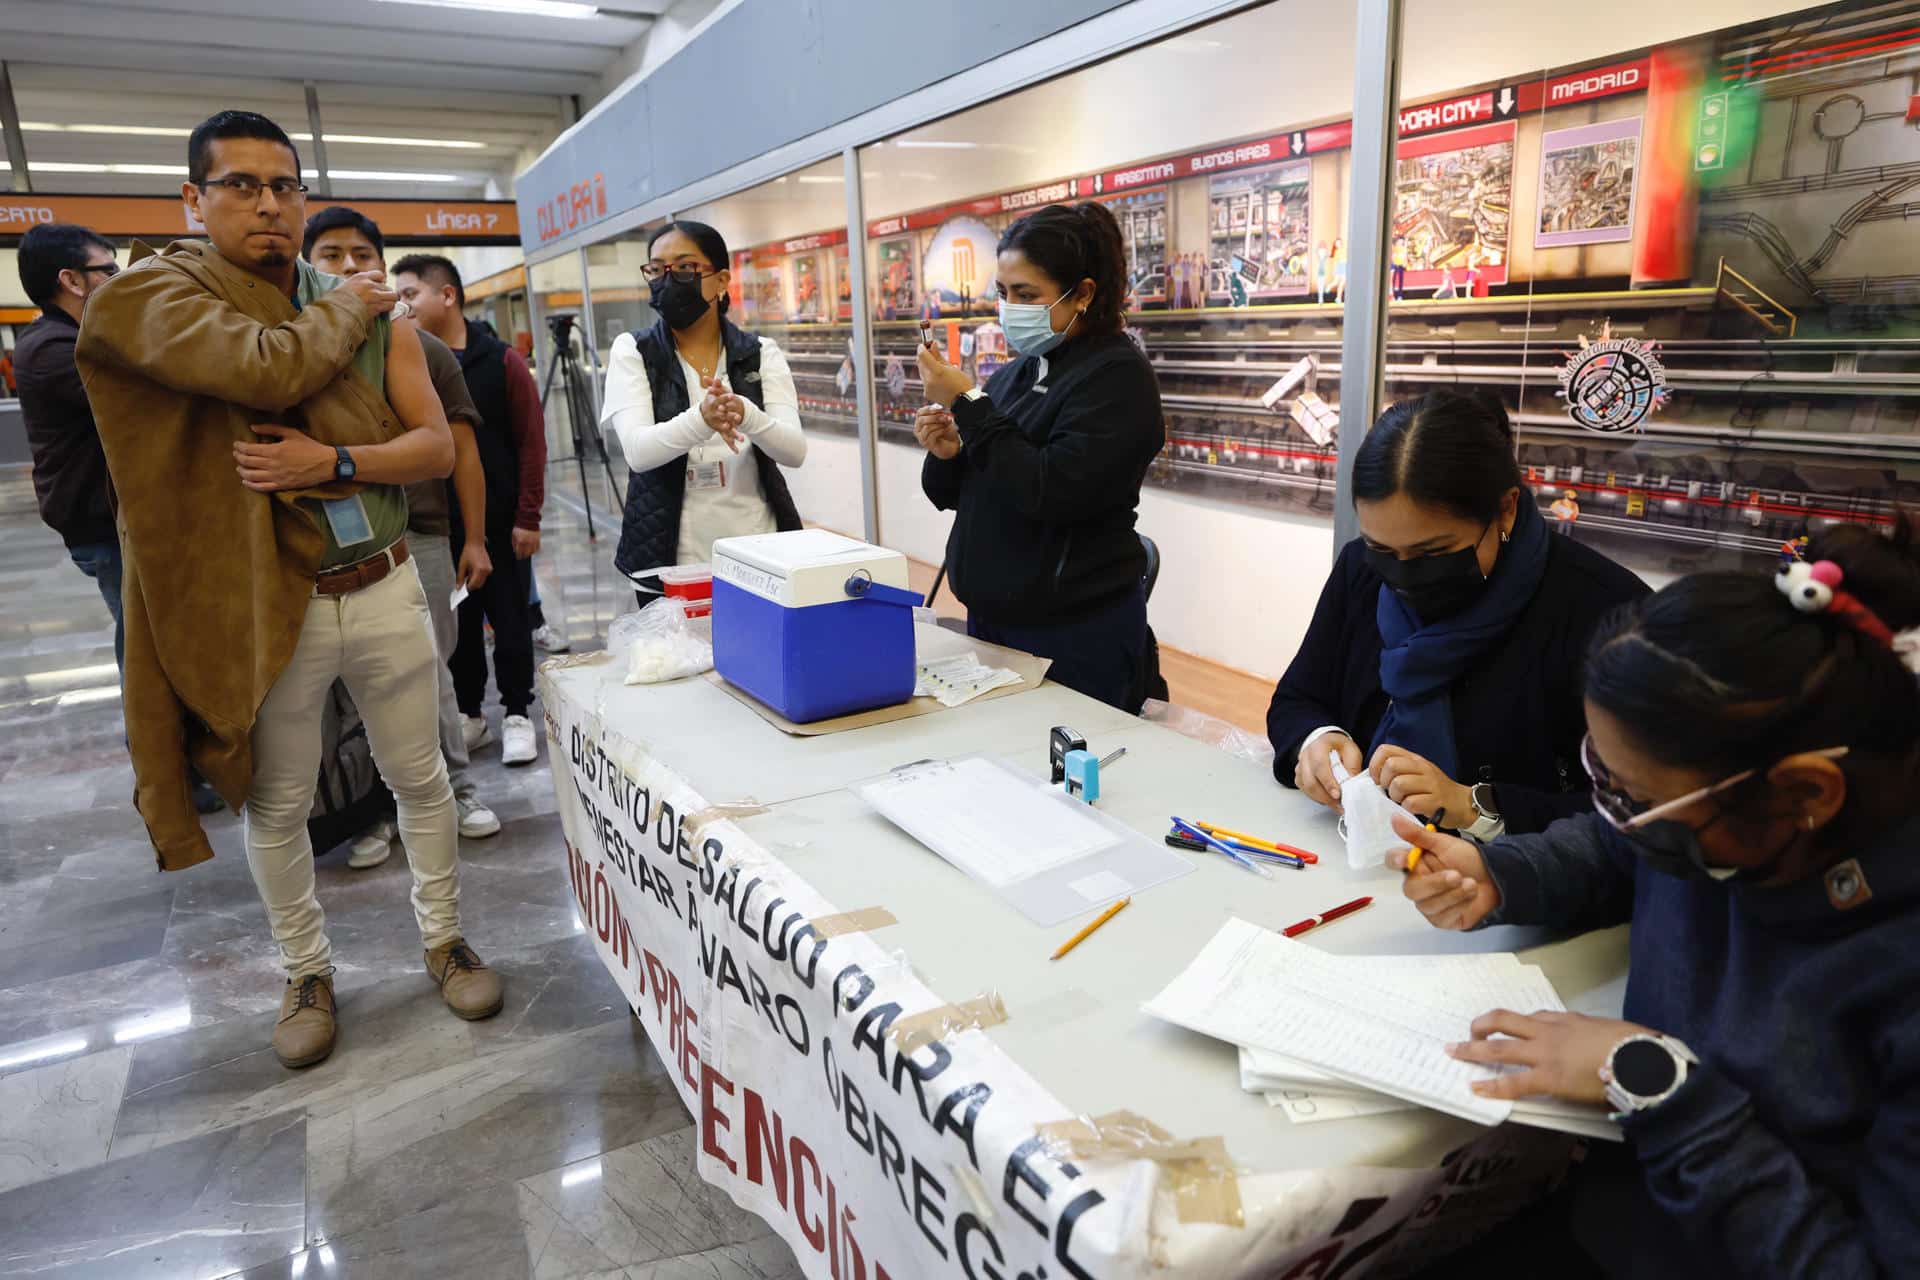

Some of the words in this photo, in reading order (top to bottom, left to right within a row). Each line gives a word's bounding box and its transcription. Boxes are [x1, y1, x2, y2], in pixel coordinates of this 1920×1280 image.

[1551, 68, 1640, 101] MADRID
[1398, 107, 1441, 131] YORK
[1442, 98, 1481, 124] CITY
[1191, 150, 1234, 172] BUENOS
[1235, 143, 1272, 164] AIRES
[1113, 163, 1175, 188] ARGENTINA
[536, 179, 594, 242] CULTURA
[1001, 189, 1037, 211] BUENOS
[485, 213, 498, 230] 7
[571, 724, 650, 835] DISTRITO
[657, 800, 698, 872] DE
[699, 838, 828, 989] SALUD
[832, 964, 993, 1173] PARA
[687, 880, 810, 1057] ÁVARO
